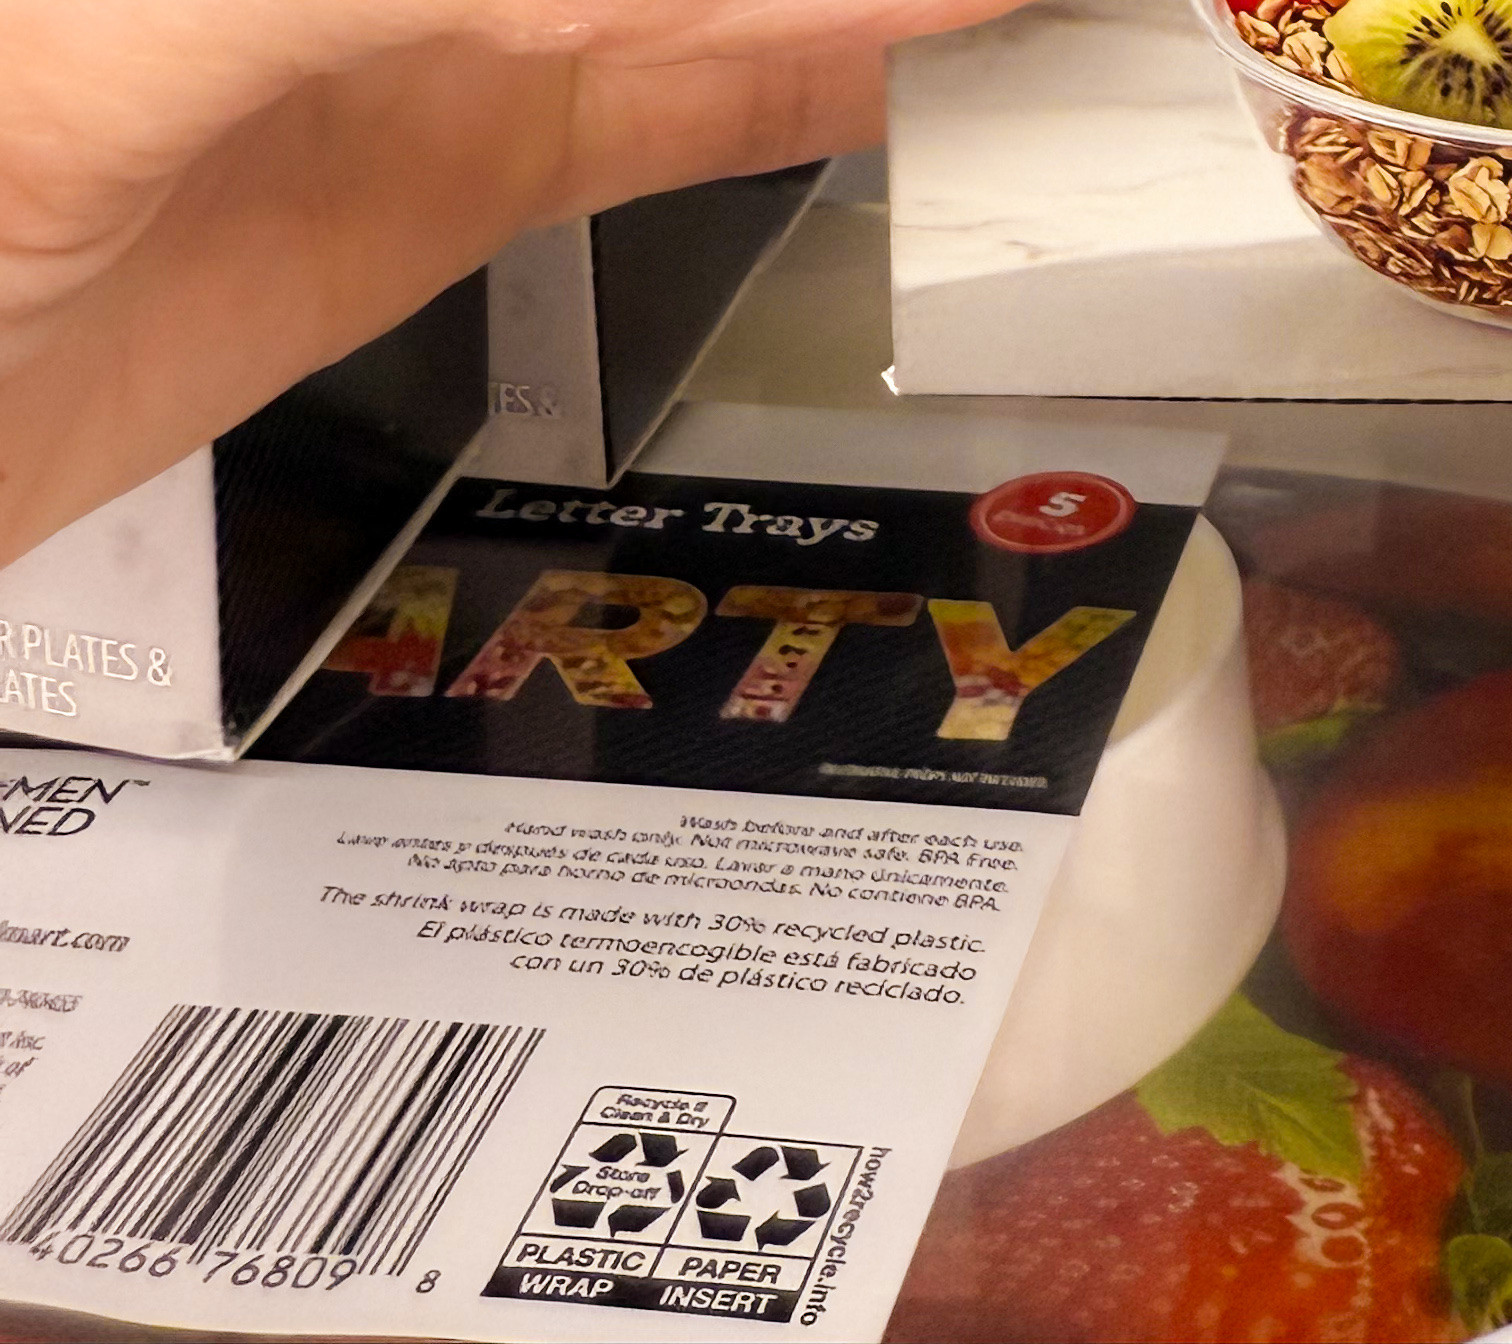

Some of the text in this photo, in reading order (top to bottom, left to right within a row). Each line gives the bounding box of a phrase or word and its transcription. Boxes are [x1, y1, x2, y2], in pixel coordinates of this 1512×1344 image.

[475, 488, 880, 547] Letter Trays
[1039, 492, 1087, 518] 5
[22, 623, 138, 681] PLATES
[147, 647, 171, 686] &
[322, 565, 1137, 740] ARTY
[0, 669, 77, 717] ATES
[0, 806, 96, 835] NED
[809, 881, 843, 899] No
[319, 885, 367, 907] The
[371, 890, 453, 912] shrink
[460, 898, 527, 919] wrap
[531, 901, 556, 919] is
[559, 904, 636, 926] made
[642, 910, 702, 932] with
[708, 913, 764, 935] 30%
[772, 920, 889, 945] recycled
[417, 919, 978, 983] El plástico termoencogible está fabricado
[510, 952, 966, 1005] con un 30% de plástico reciclado.
[600, 1106, 653, 1122] Clean
[676, 1112, 710, 1128] Dry
[596, 1165, 650, 1184] Store
[29, 1229, 441, 1295] 40266 76809 8
[516, 1243, 783, 1285] PLASTIC PAPER
[519, 1272, 778, 1315] WRAP INSERT
